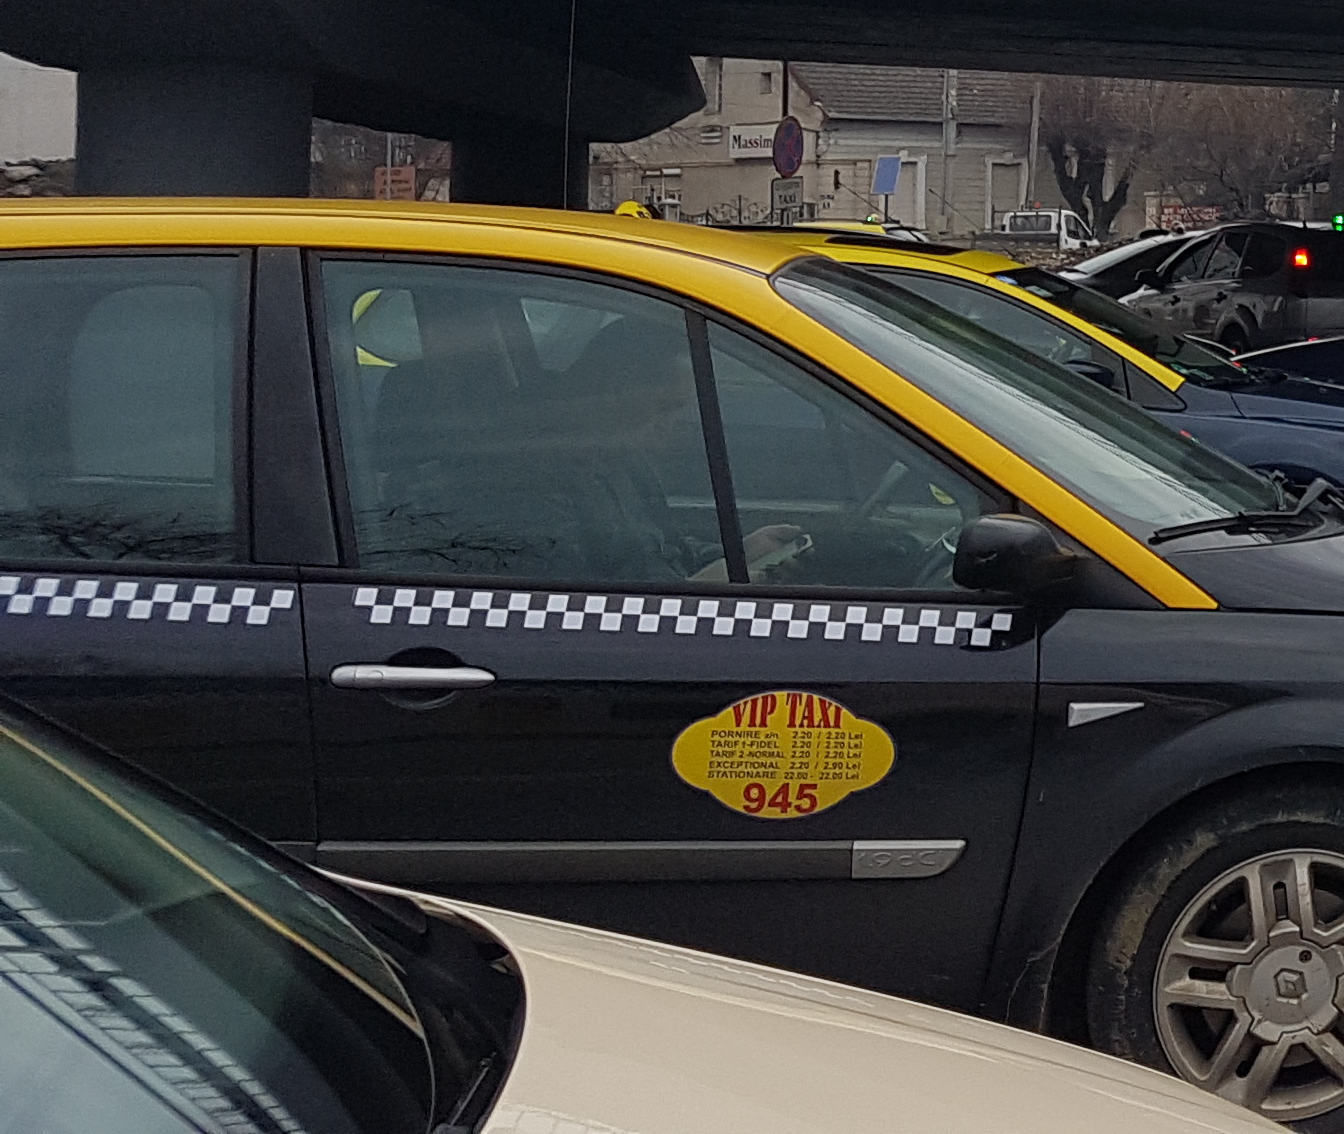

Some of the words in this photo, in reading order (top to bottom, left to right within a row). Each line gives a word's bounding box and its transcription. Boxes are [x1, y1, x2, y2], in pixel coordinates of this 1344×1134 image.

[732, 693, 777, 728] VIP
[786, 692, 845, 729] TAXI
[710, 730, 761, 739] PORNIRE
[710, 740, 739, 748] TARIF
[743, 782, 819, 814] 945
